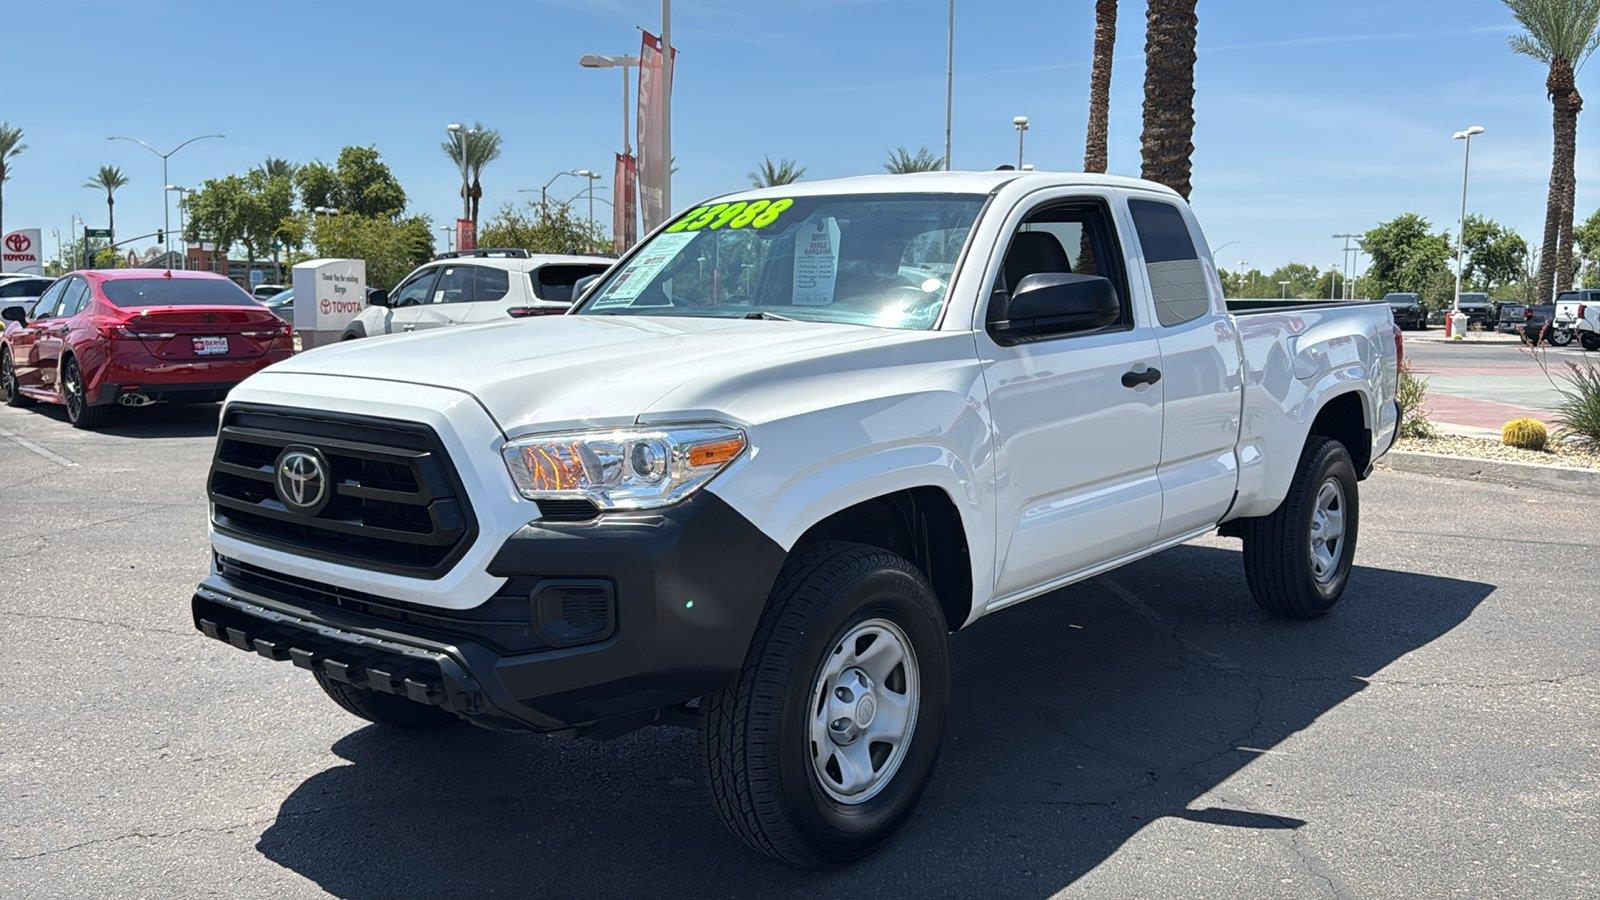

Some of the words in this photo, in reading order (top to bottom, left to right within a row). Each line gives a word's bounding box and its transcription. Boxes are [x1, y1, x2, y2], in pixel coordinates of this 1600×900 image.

[664, 198, 794, 233] 23988
[3, 253, 37, 262] TOYOTA
[322, 272, 333, 281] Thank
[334, 284, 346, 295] Berge
[332, 301, 363, 313] TOYOTA
